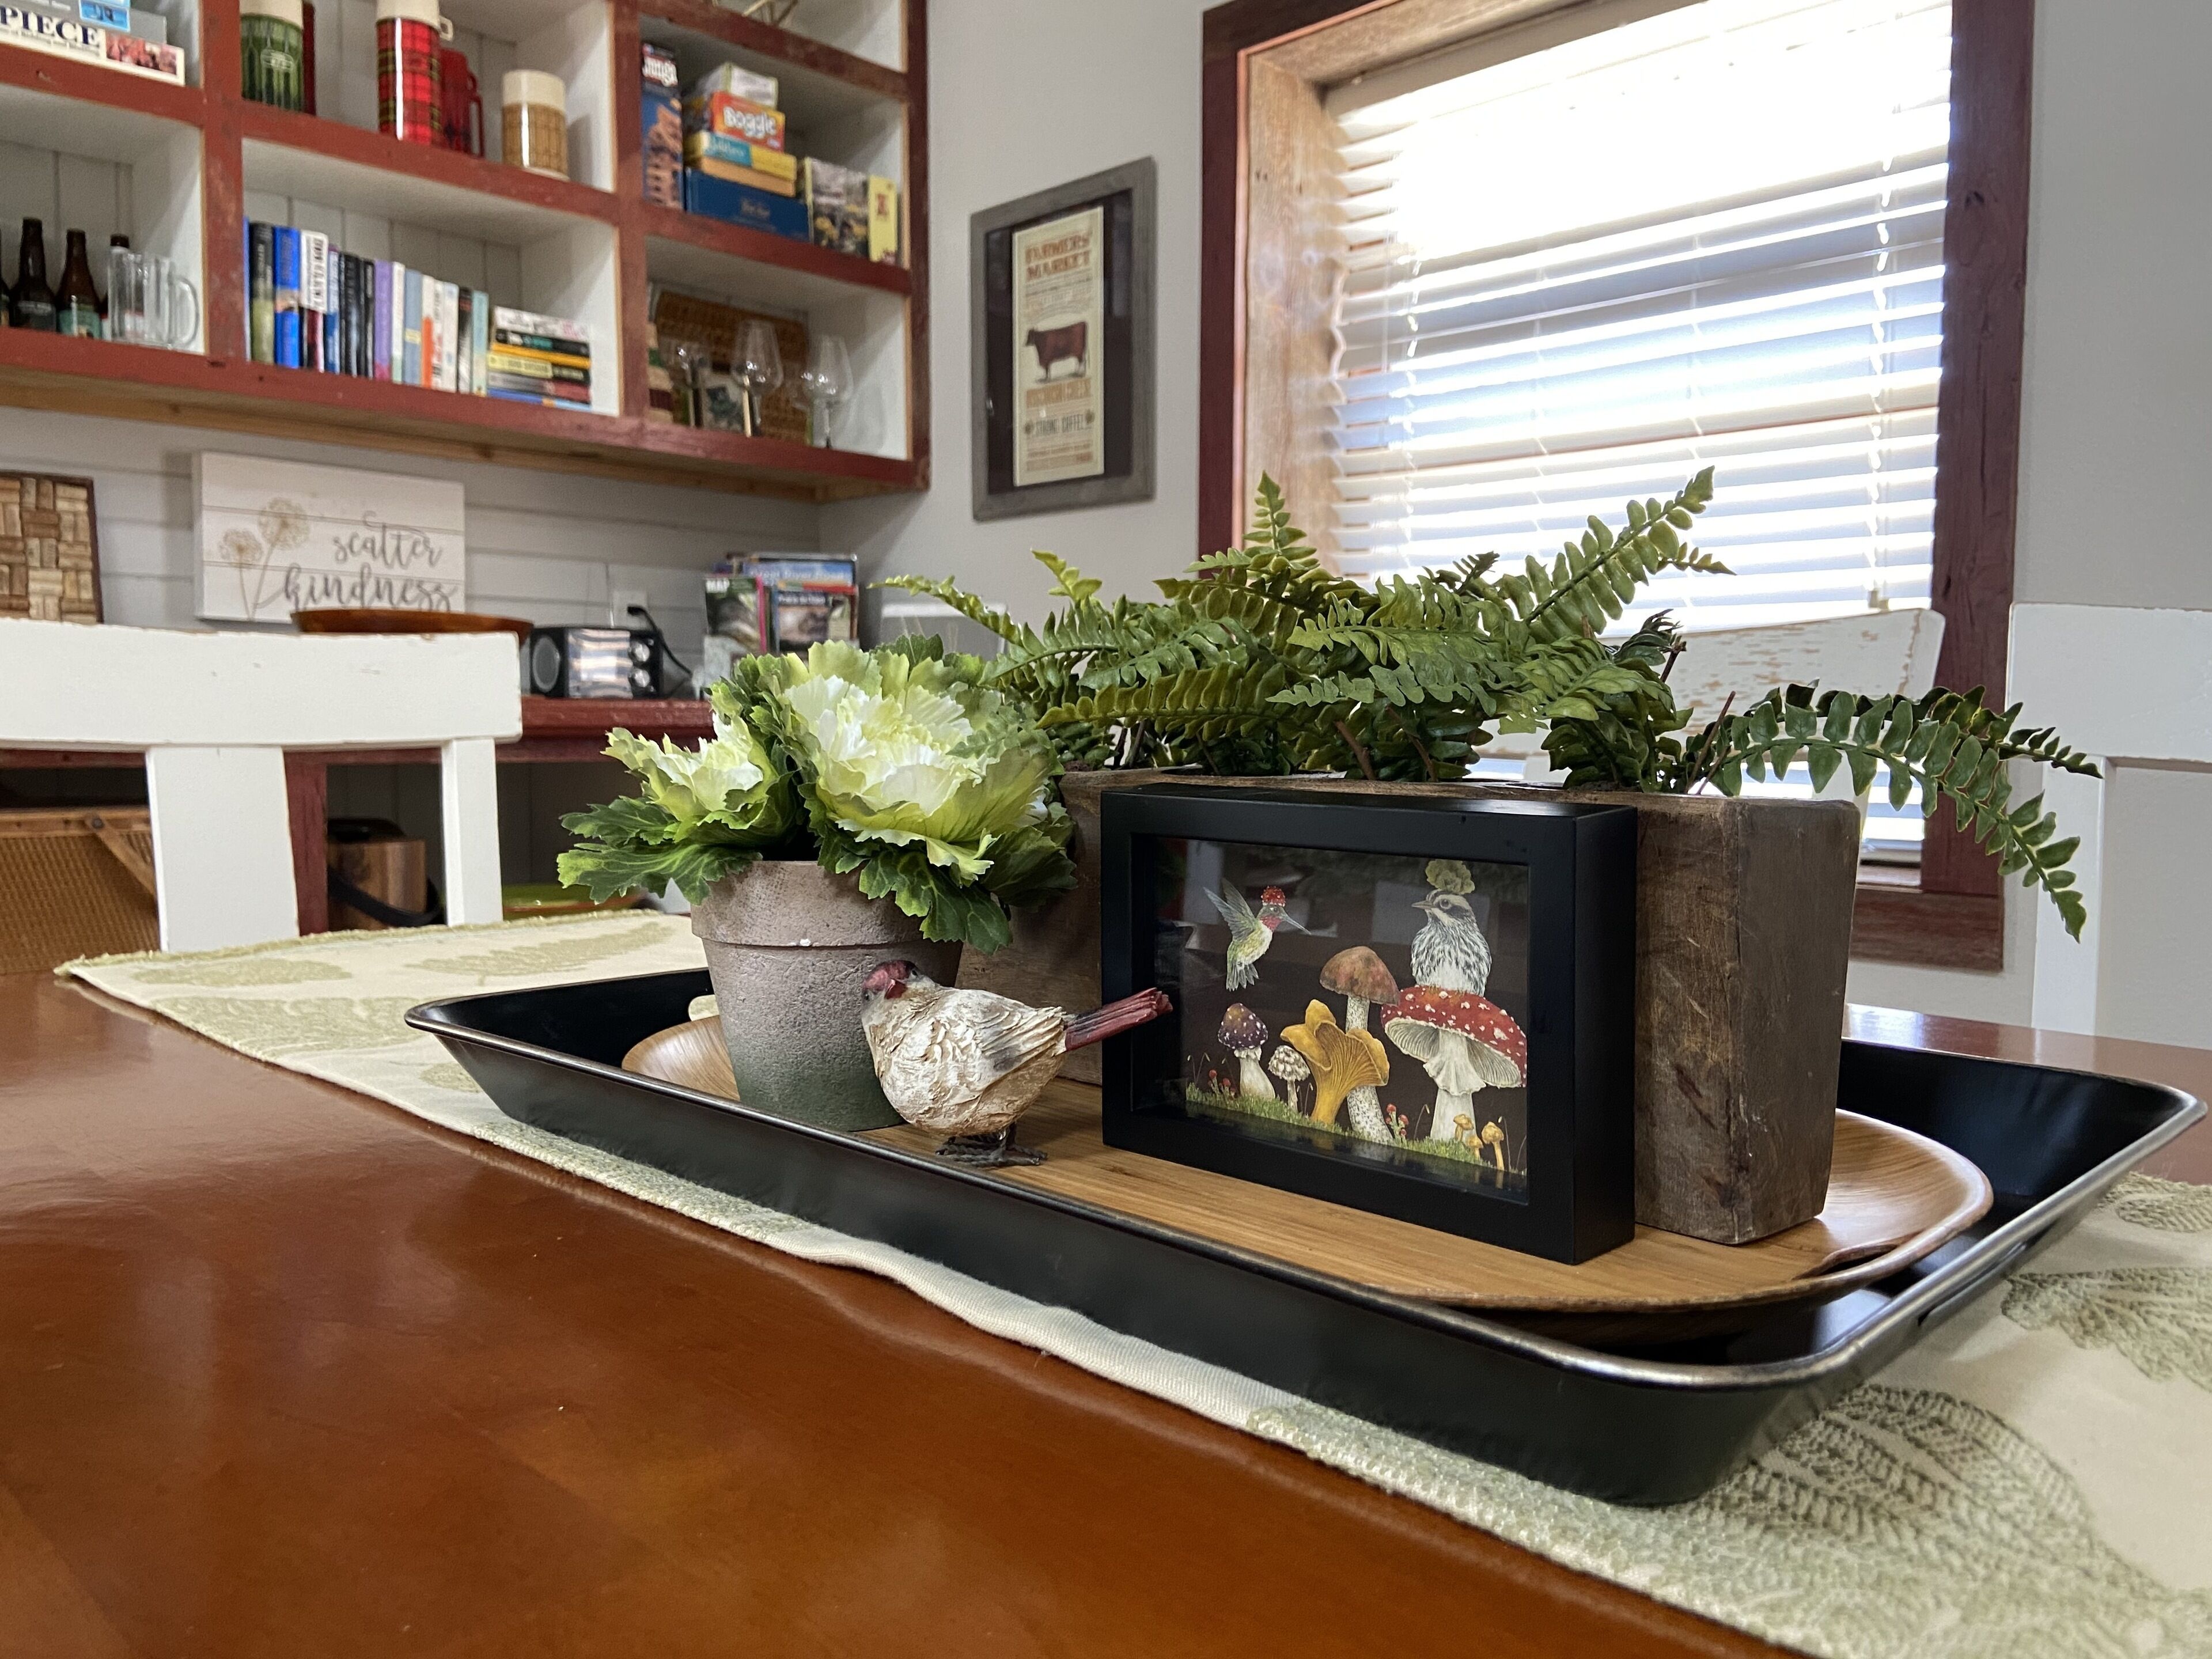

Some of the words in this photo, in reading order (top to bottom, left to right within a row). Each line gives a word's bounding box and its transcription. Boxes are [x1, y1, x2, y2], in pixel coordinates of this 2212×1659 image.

[0, 5, 100, 47] PIECE
[723, 106, 777, 139] Boggle
[1026, 250, 1090, 282] MARKET
[333, 512, 443, 570] scatter
[283, 562, 459, 612] kindness
